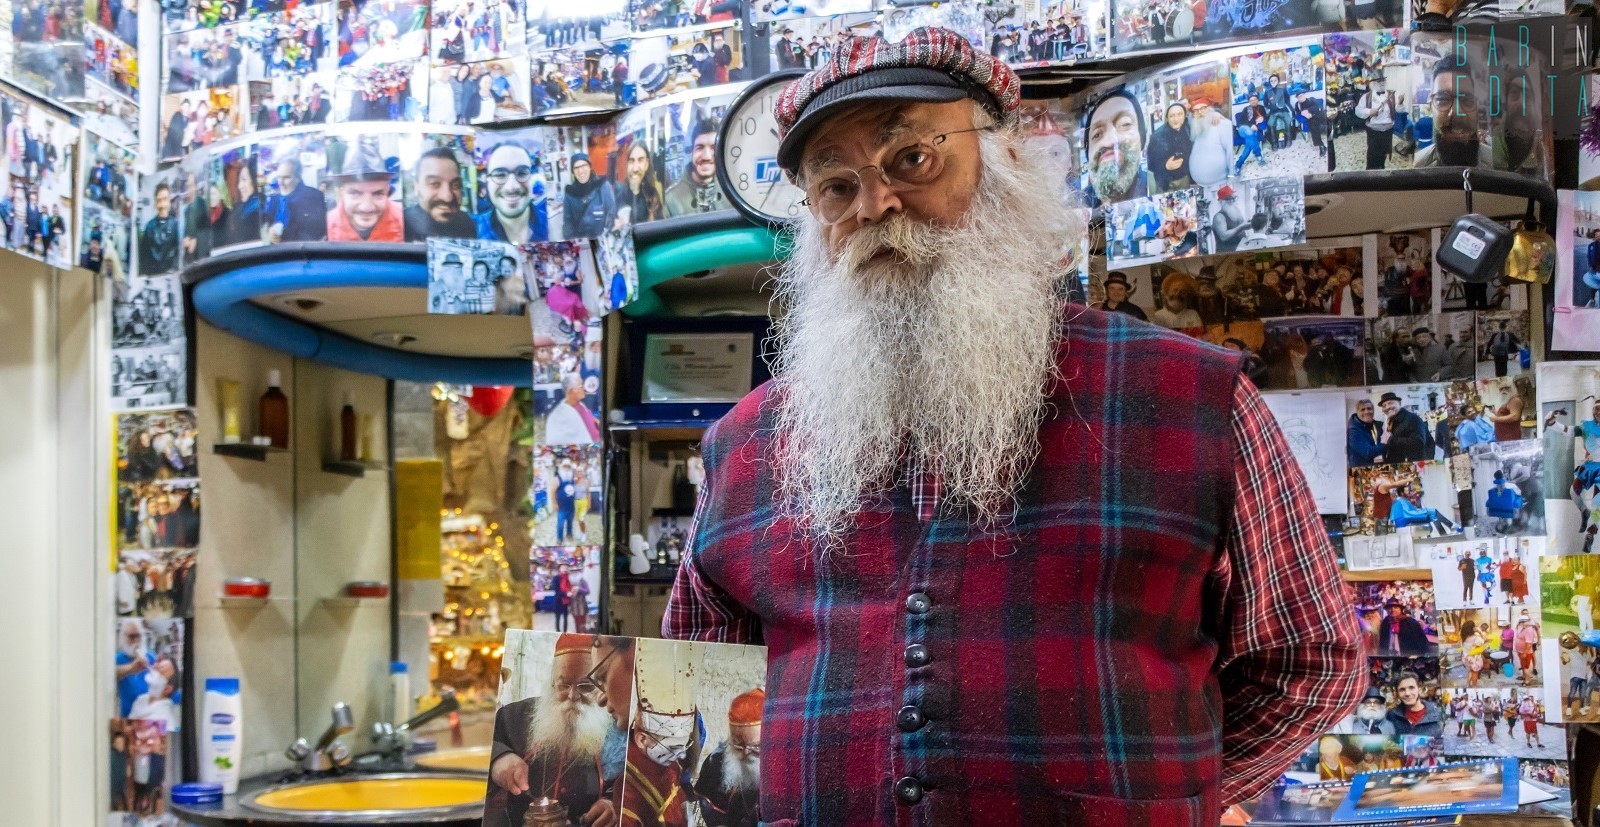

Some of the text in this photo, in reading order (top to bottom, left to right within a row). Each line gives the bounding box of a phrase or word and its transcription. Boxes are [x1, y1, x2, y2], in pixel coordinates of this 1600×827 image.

[760, 95, 773, 114] 11
[739, 117, 757, 136] 10
[730, 145, 742, 164] 9
[739, 172, 749, 191] 8
[787, 195, 799, 216] 6
